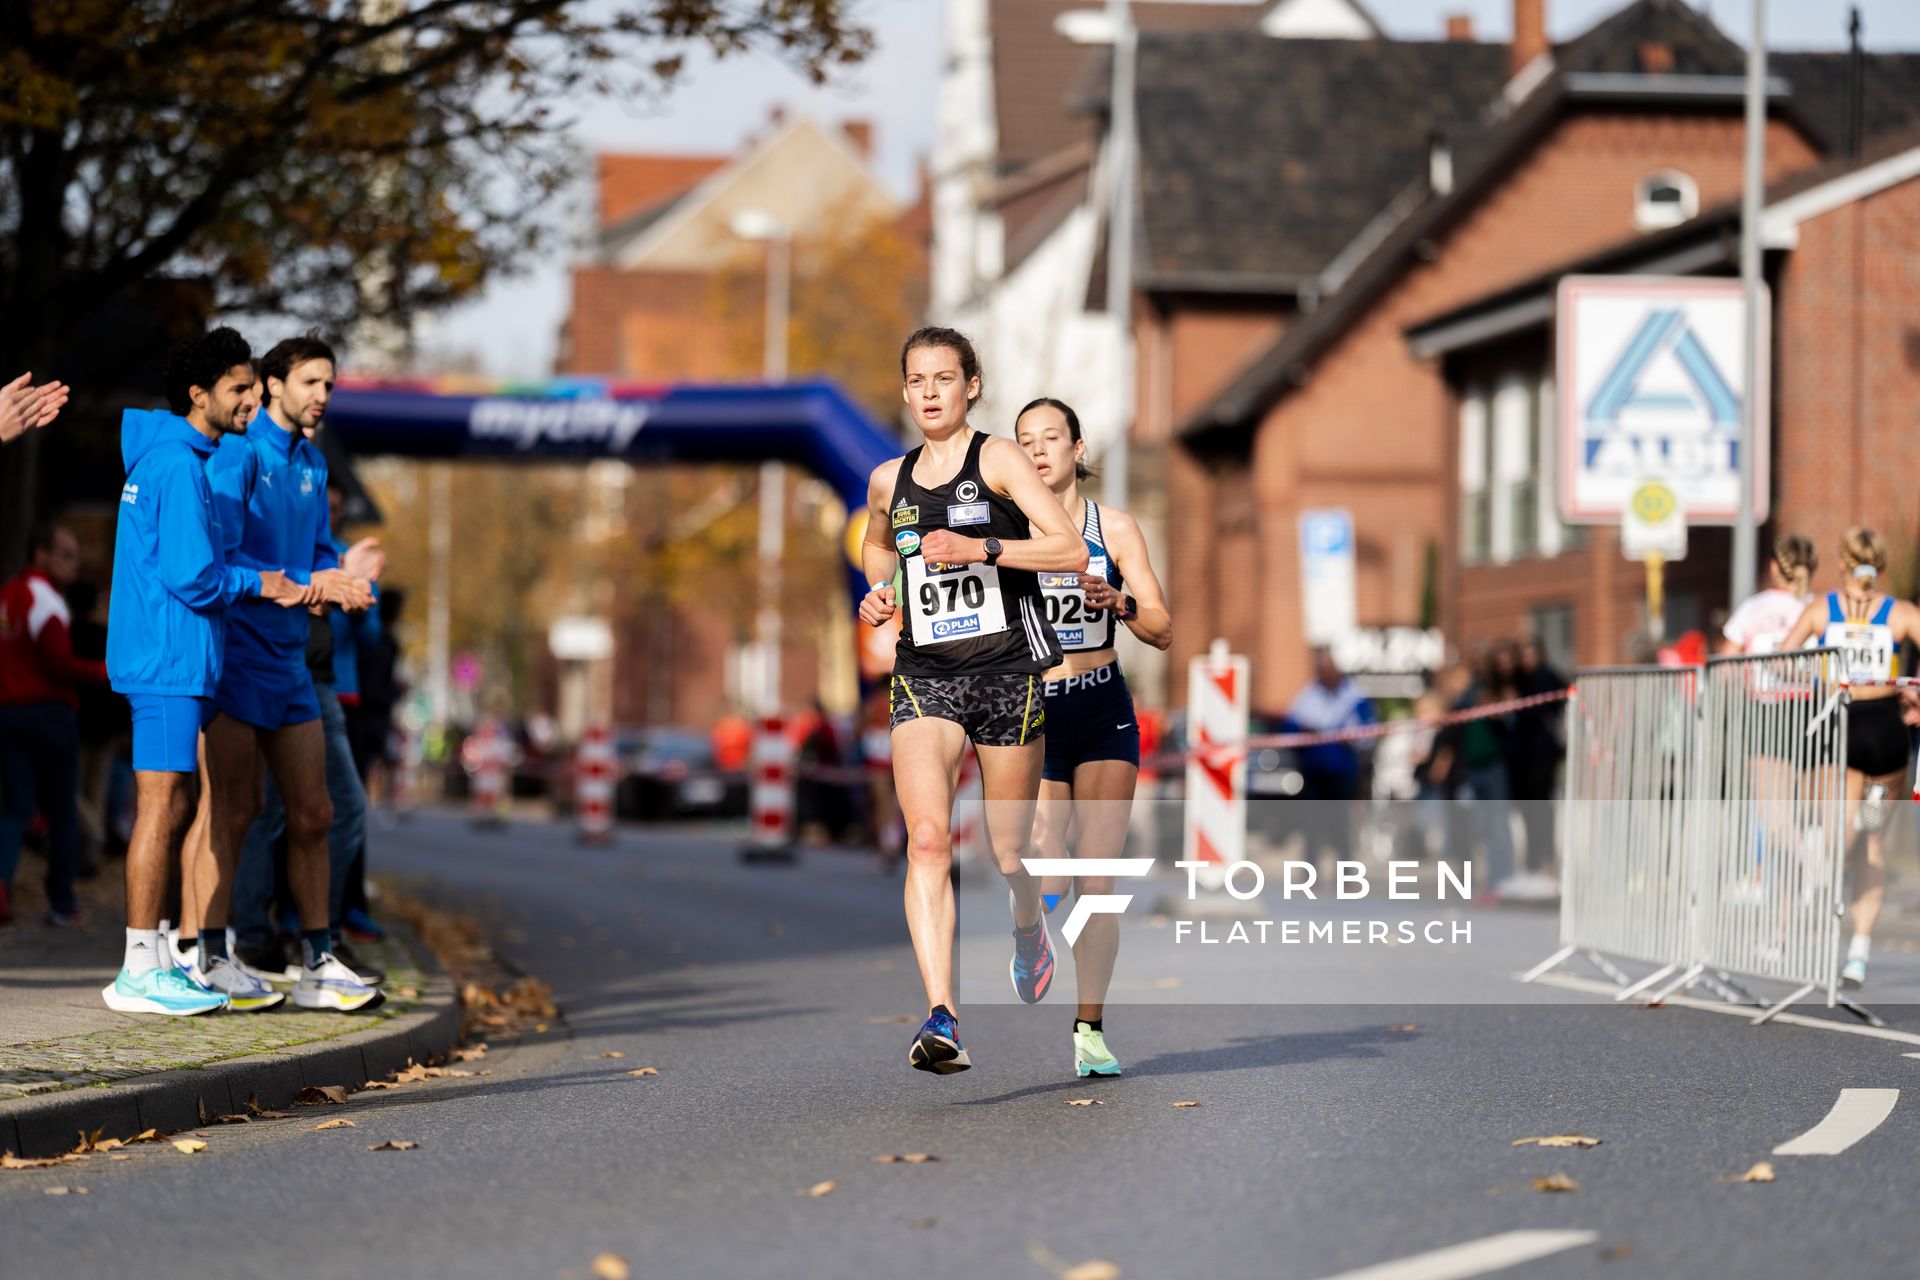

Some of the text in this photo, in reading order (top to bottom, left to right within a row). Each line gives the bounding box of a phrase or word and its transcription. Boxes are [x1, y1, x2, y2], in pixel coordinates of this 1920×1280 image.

[919, 575, 985, 616] 970
[951, 617, 978, 630] PLAN
[1058, 631, 1082, 641] PLAN
[1064, 665, 1112, 695] PRO
